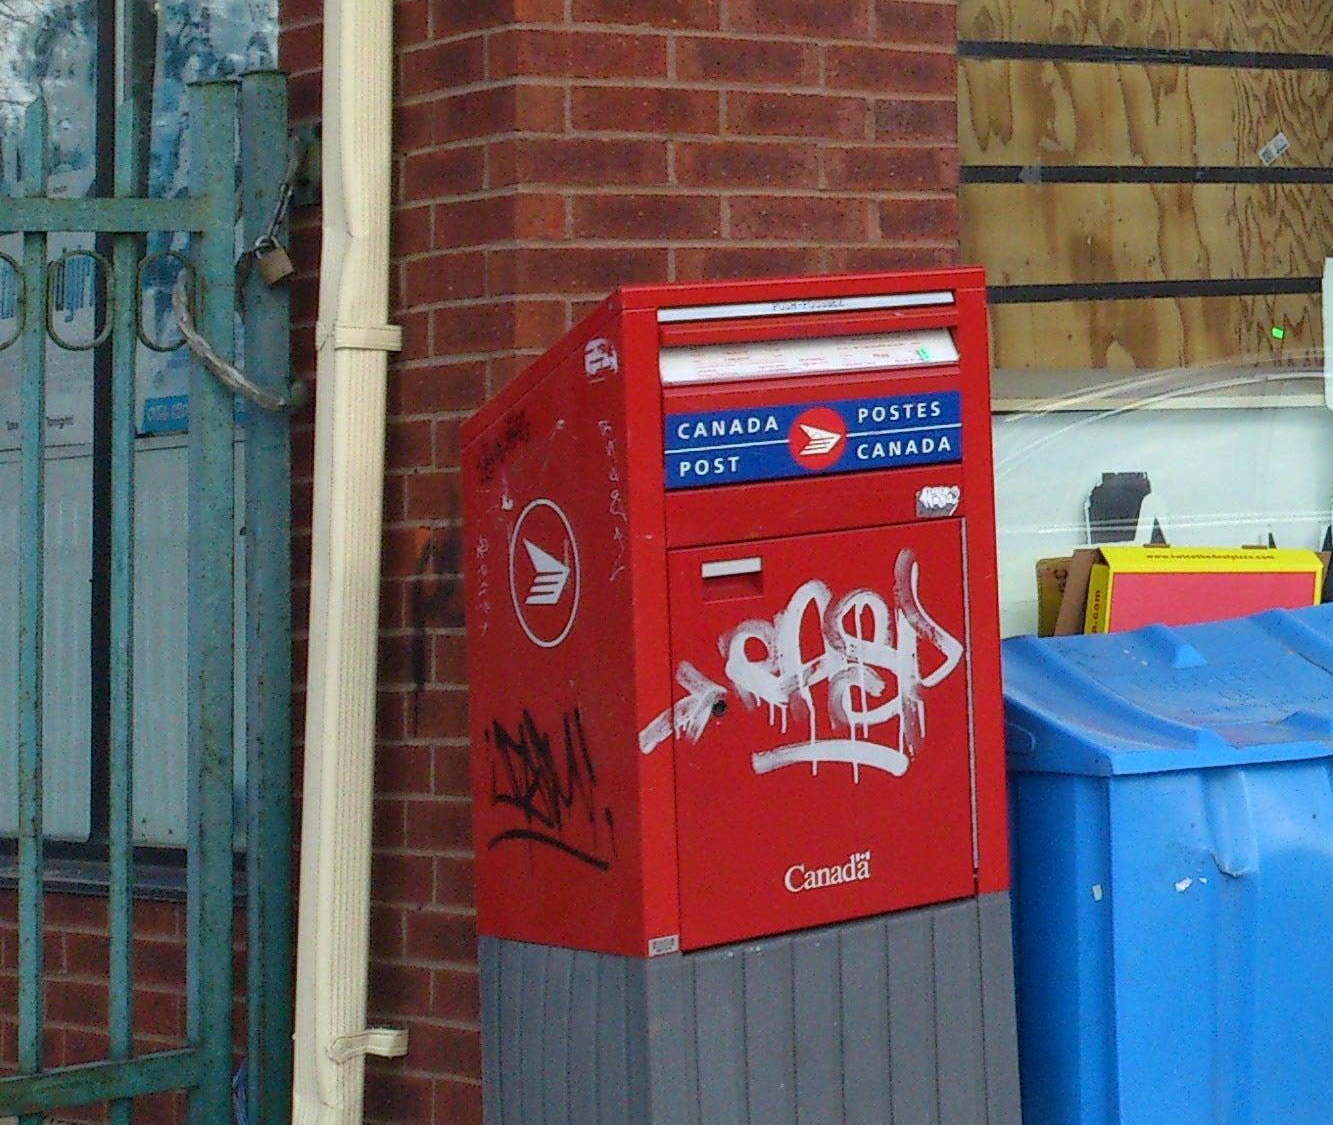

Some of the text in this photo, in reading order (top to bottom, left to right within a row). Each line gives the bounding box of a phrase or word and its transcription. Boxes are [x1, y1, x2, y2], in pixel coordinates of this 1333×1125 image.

[857, 400, 942, 424] POSTES
[677, 415, 780, 440] CANADA
[856, 436, 952, 461] CANADA
[678, 455, 741, 478] POST
[783, 850, 872, 893] Canada
